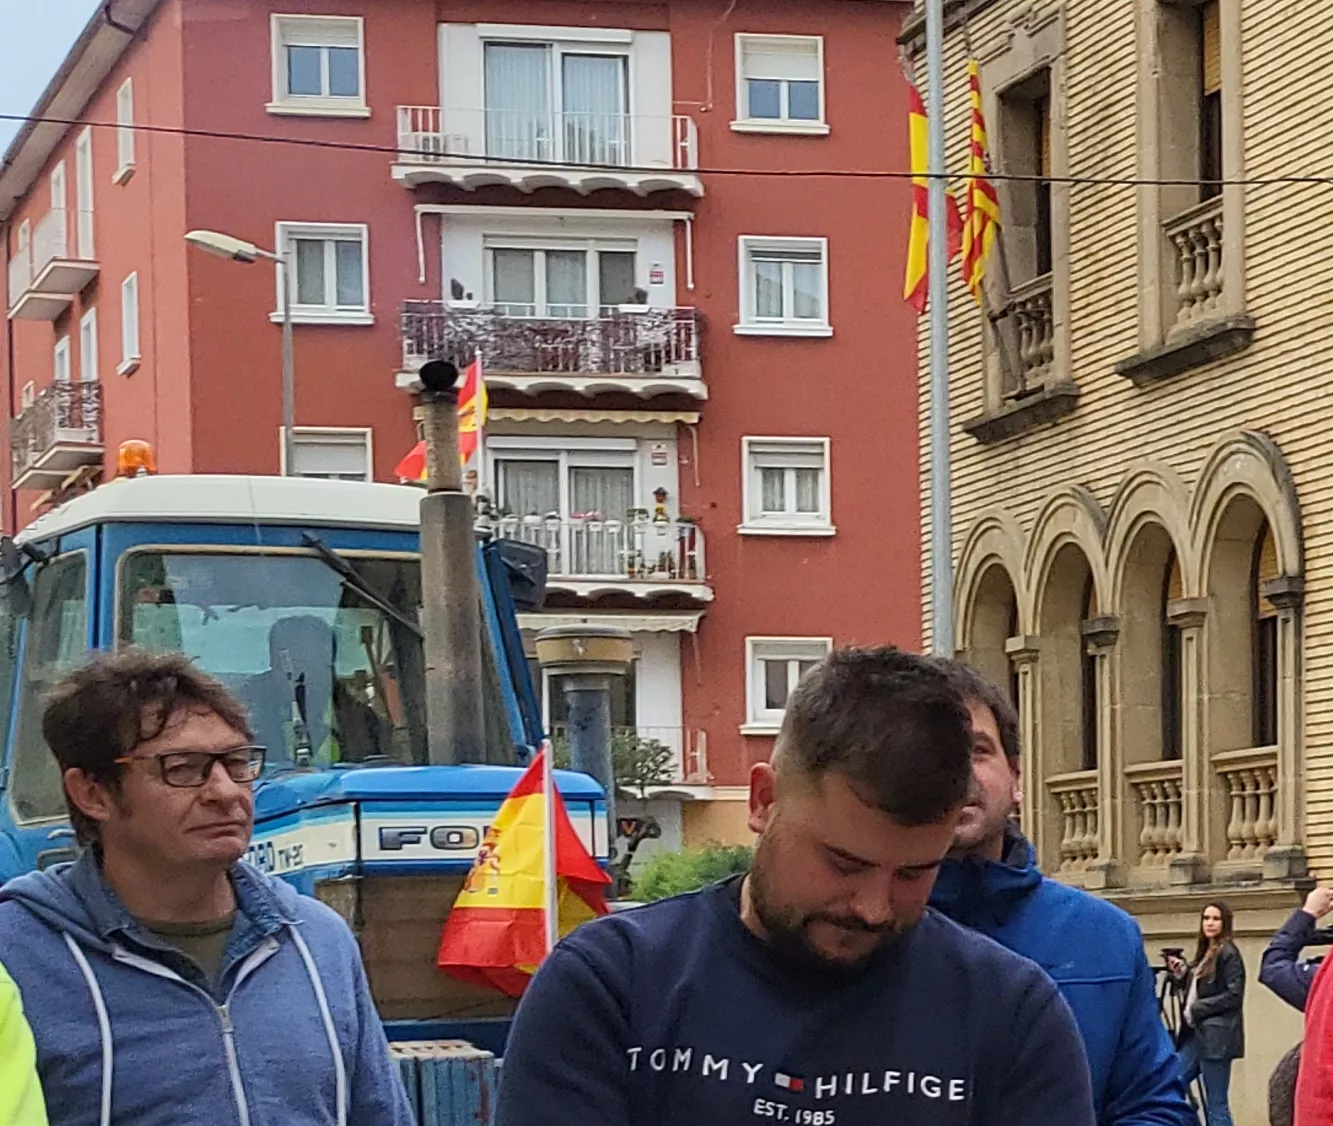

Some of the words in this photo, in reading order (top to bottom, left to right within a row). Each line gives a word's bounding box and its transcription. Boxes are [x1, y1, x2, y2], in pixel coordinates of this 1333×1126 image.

[378, 825, 491, 852] FO
[626, 1046, 765, 1085] TOMMY
[814, 1069, 973, 1101] HILFIGE
[752, 1097, 790, 1123] EST.
[795, 1108, 836, 1126] 1985
